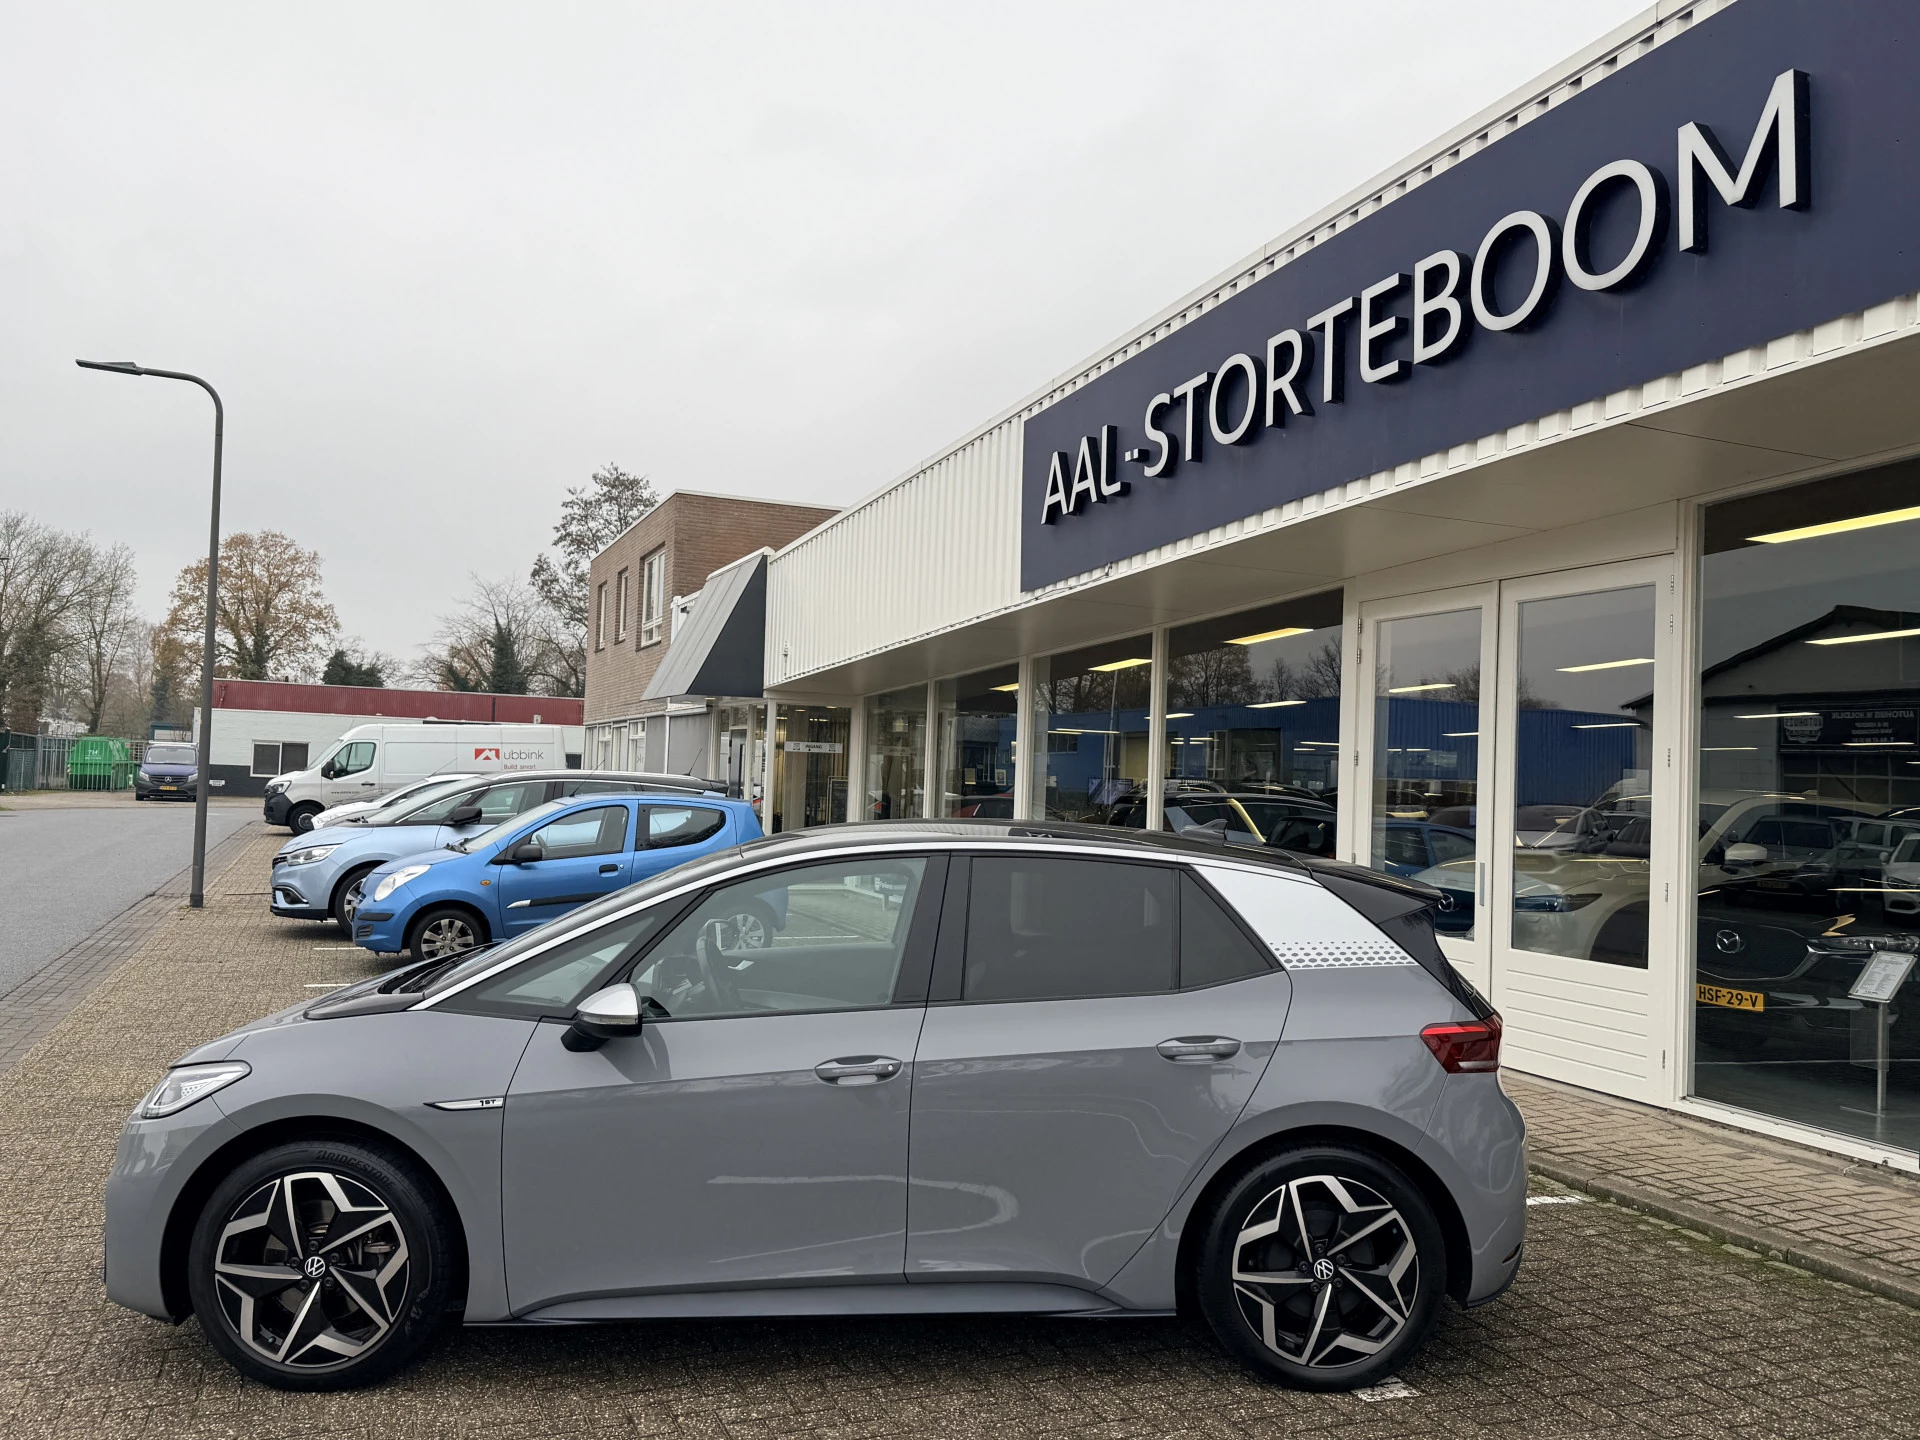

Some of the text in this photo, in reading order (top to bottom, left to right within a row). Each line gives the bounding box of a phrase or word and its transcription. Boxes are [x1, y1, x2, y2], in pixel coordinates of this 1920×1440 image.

[1040, 68, 1798, 525] AAL-STORTEBOOM
[503, 749, 544, 760] ubbink
[1698, 986, 1758, 1009] HSF-29-V
[316, 1150, 395, 1188] BRIDGESTONE
